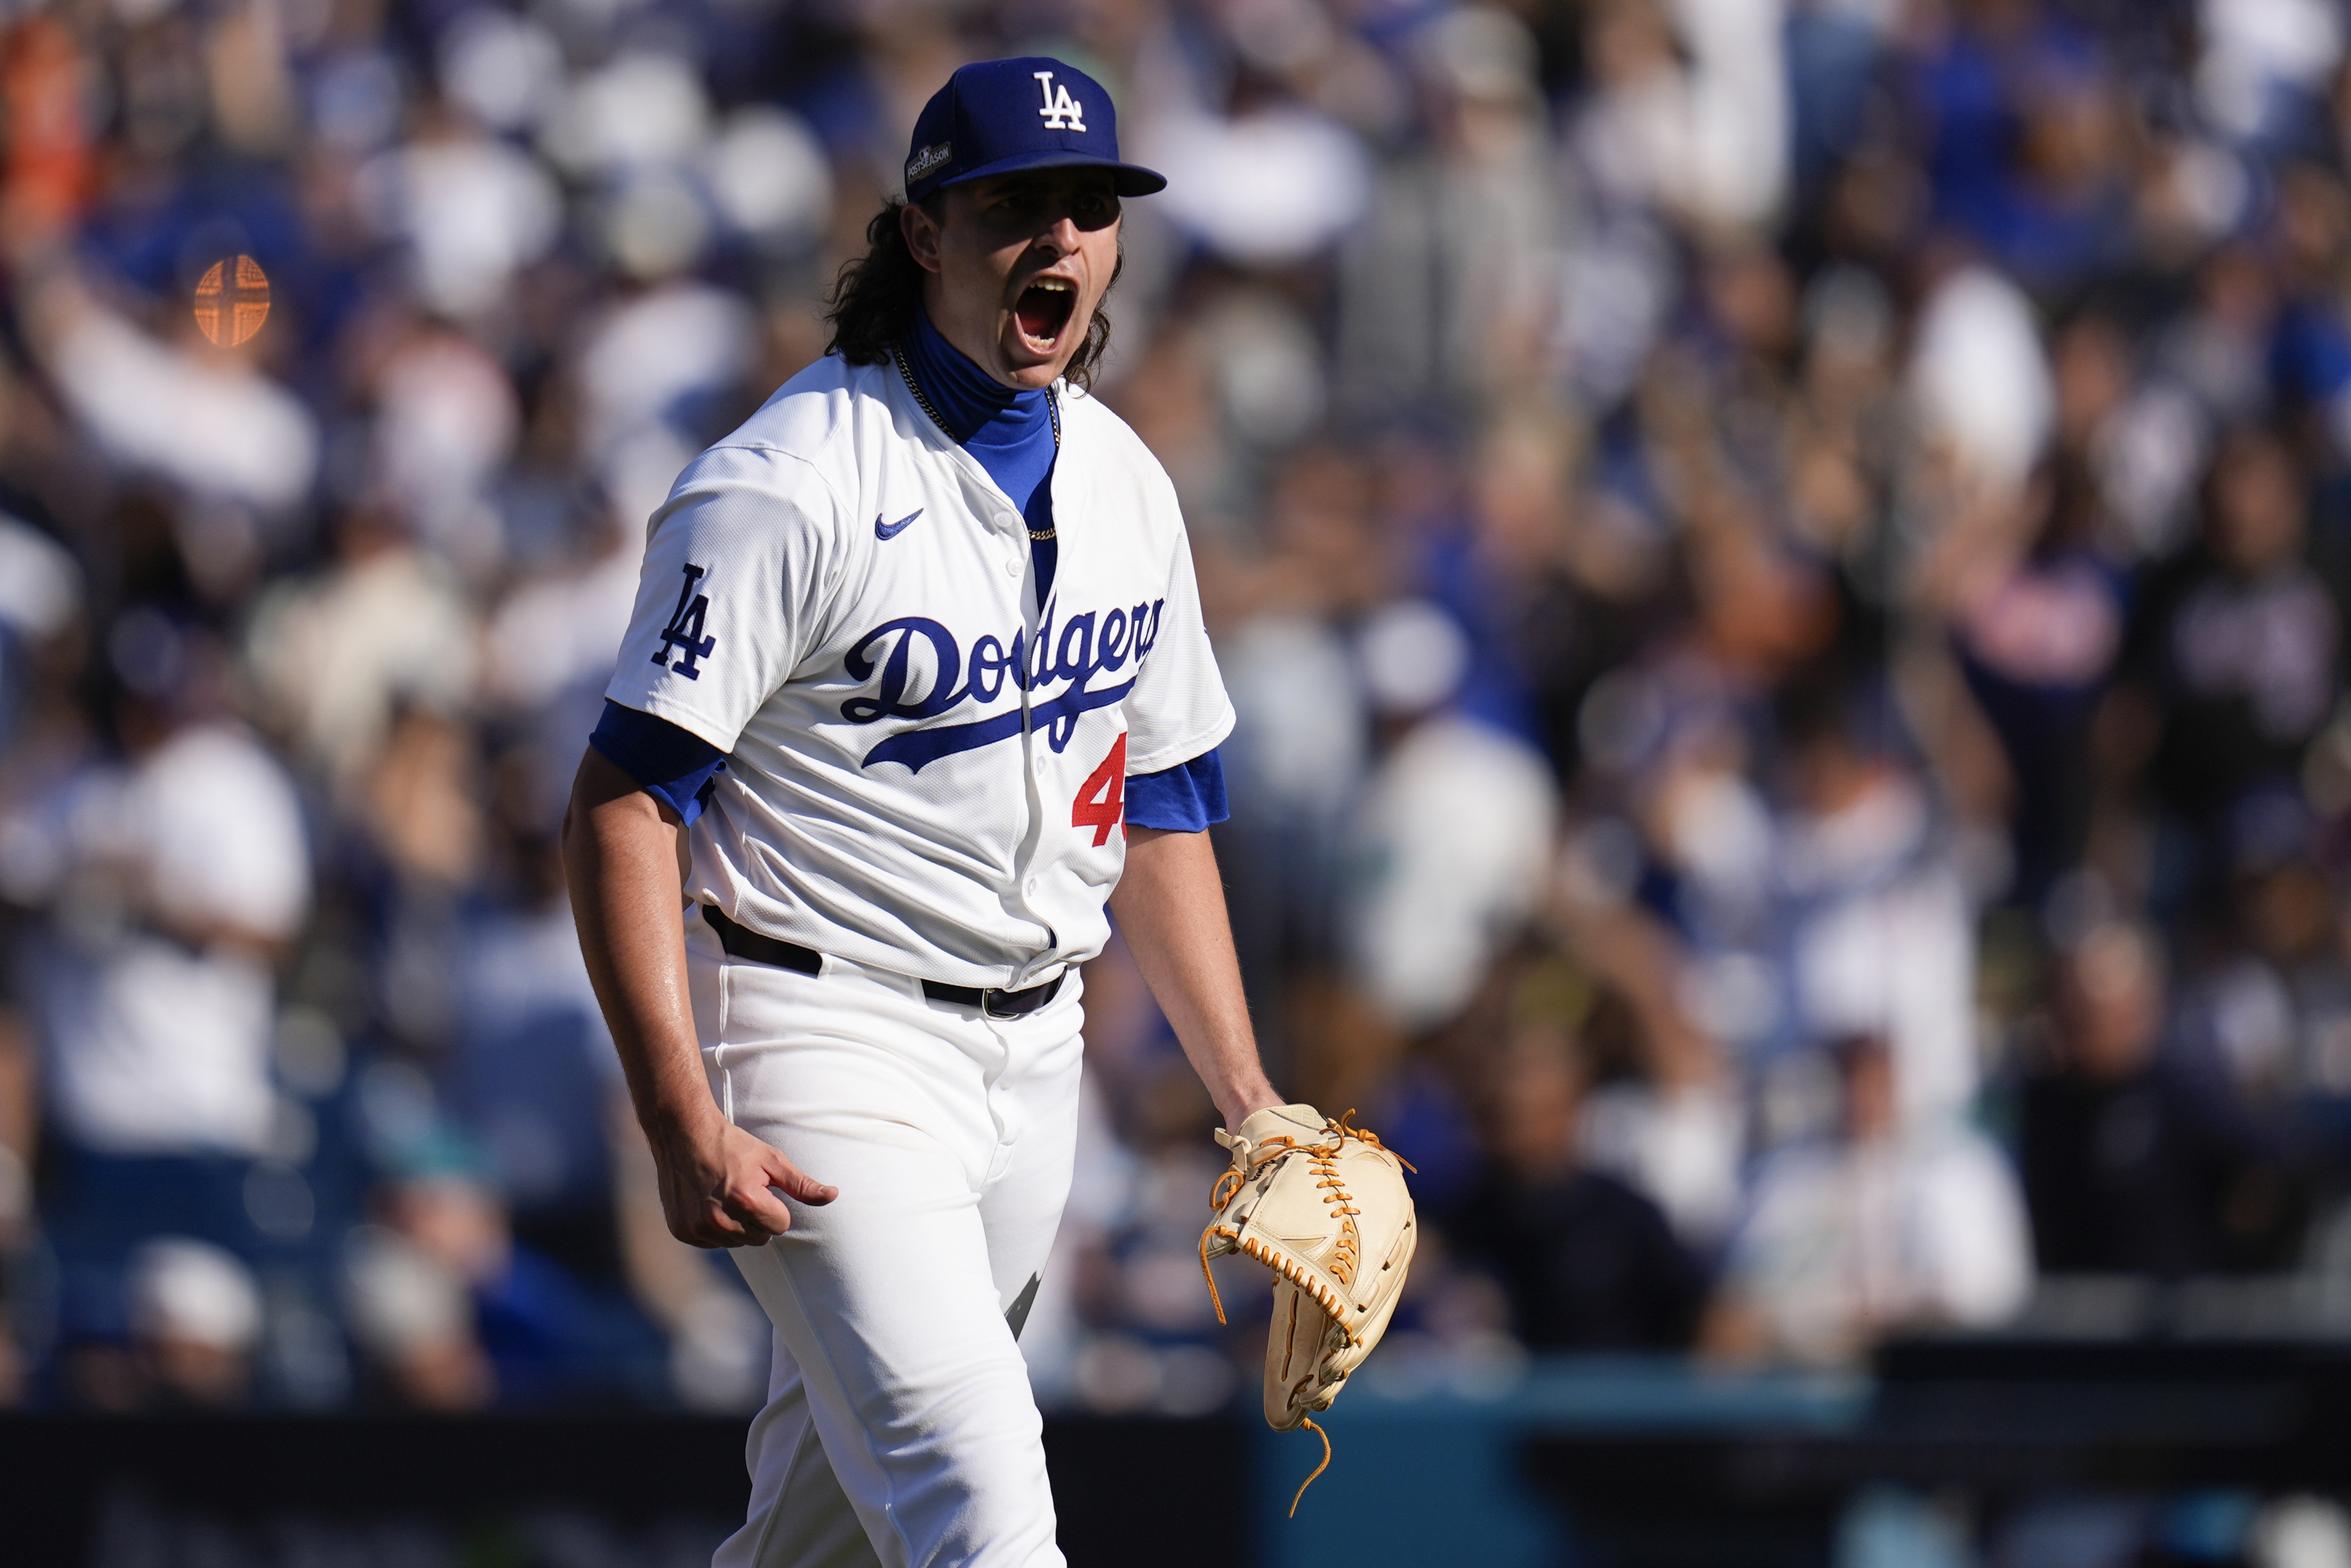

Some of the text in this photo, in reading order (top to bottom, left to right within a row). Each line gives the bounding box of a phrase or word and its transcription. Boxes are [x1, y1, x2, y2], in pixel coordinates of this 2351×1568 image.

[1033, 71, 1086, 132] LA
[908, 146, 949, 178] POSTSEASON
[651, 563, 716, 681] LA
[1072, 731, 1127, 847] 4
